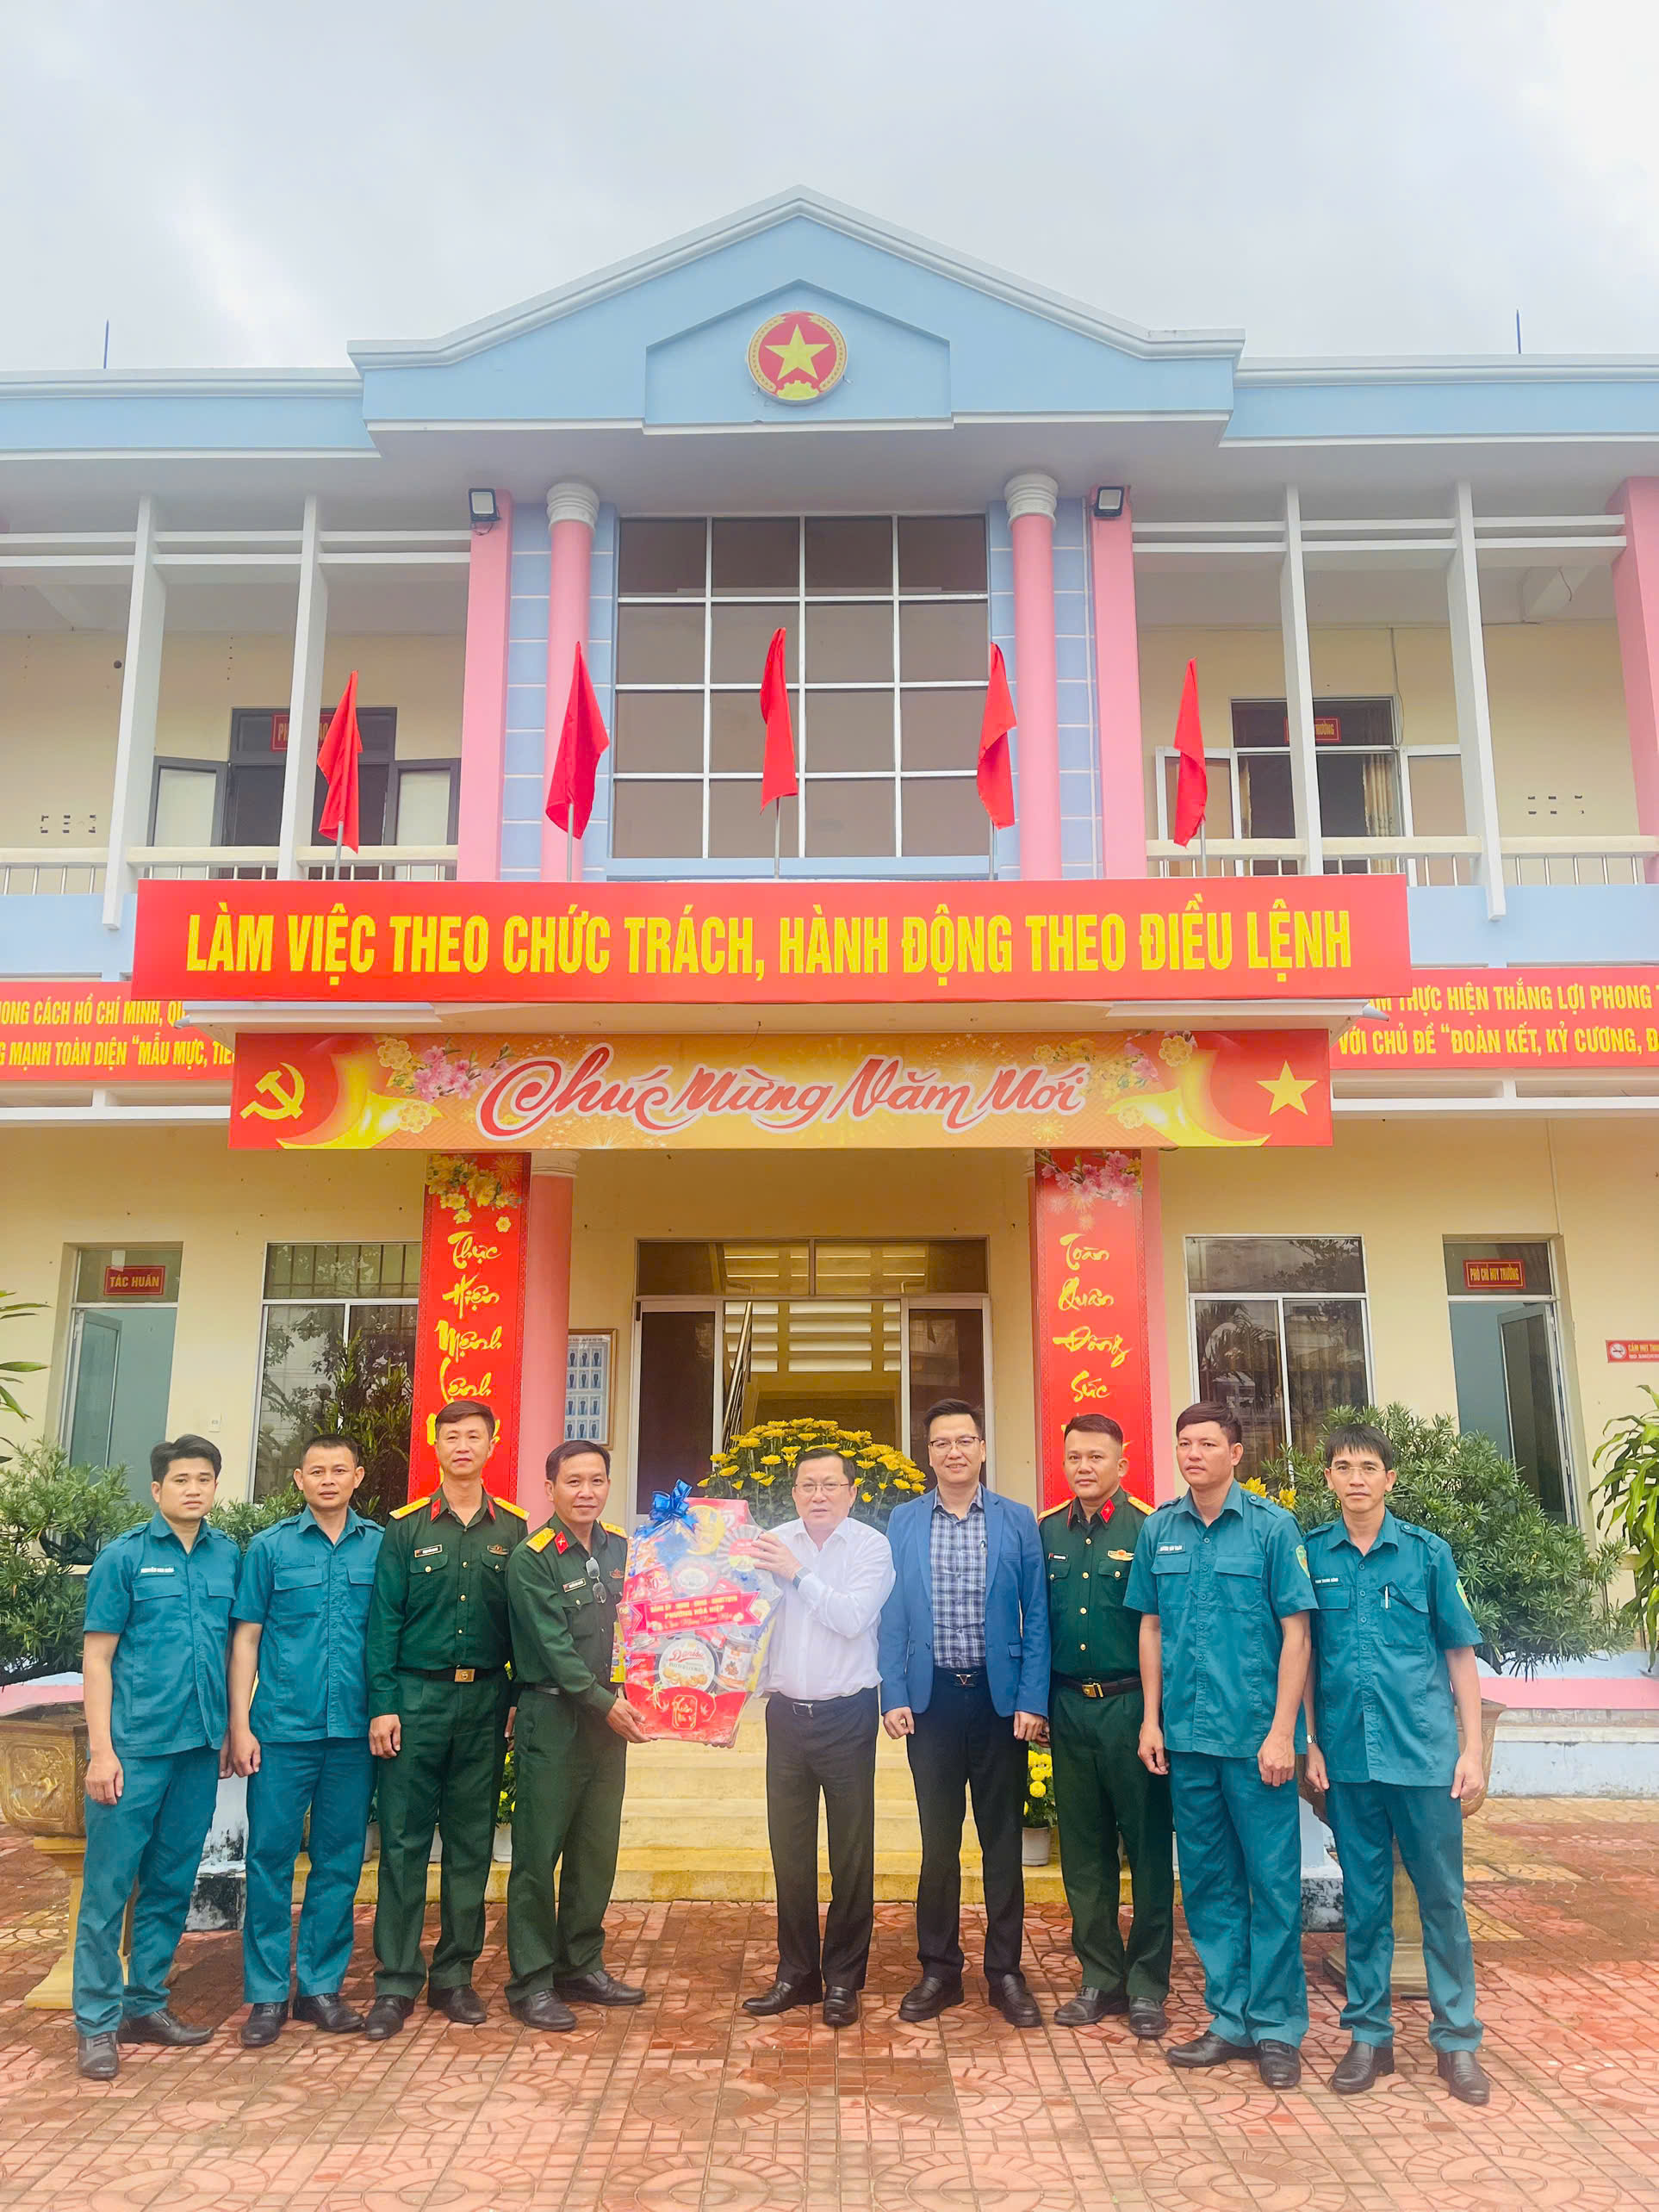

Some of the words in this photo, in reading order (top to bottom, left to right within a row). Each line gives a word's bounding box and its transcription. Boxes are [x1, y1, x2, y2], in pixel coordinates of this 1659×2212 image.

[187, 903, 274, 972] LÀM
[288, 903, 376, 985] VIỆC
[389, 915, 488, 973] THEO
[503, 904, 610, 973] CHỨC
[624, 904, 765, 981] TRÁCH,
[780, 904, 888, 973] HÀNH
[901, 904, 1012, 985] ĐỘNG
[1025, 910, 1126, 972] THEO
[1140, 893, 1233, 971] ĐIỀU
[1247, 898, 1351, 982] LỆNH
[0, 1000, 30, 1025] ONG
[34, 996, 71, 1025] CÁCH
[96, 996, 121, 1025] CHÍ
[122, 1001, 162, 1028] MINH,
[1447, 982, 1489, 1016] HIỆN
[1494, 978, 1552, 1010] THẮNG
[1557, 983, 1585, 1015] LỢI
[1590, 985, 1653, 1010] PHONG
[9, 1041, 52, 1072] MẠNH
[55, 1037, 91, 1066] TOÀN
[94, 1037, 127, 1071] DIỆN
[173, 1039, 207, 1071] MỰC,
[1339, 1025, 1368, 1055] VỚI
[1372, 1022, 1408, 1055] CHỦ
[1413, 1022, 1437, 1054] ĐỀ
[1506, 1020, 1542, 1056] KẾT,
[1546, 1019, 1569, 1053] KỶ
[1575, 1026, 1643, 1055] CƯƠNG,
[480, 1046, 696, 1137] Chúc
[670, 1066, 834, 1129] Mừng
[826, 1059, 988, 1129] Năm
[976, 1066, 1087, 1112] Mới
[447, 1231, 501, 1270] Thực
[1059, 1233, 1109, 1271] Toàn
[109, 1273, 129, 1288] TÁC
[442, 1274, 500, 1320] Hiện
[1059, 1277, 1115, 1311] Quân
[434, 1320, 503, 1364] Mệnh
[1052, 1326, 1132, 1368] Đồng
[440, 1357, 492, 1404] Lệnh
[1071, 1370, 1110, 1403] Sức
